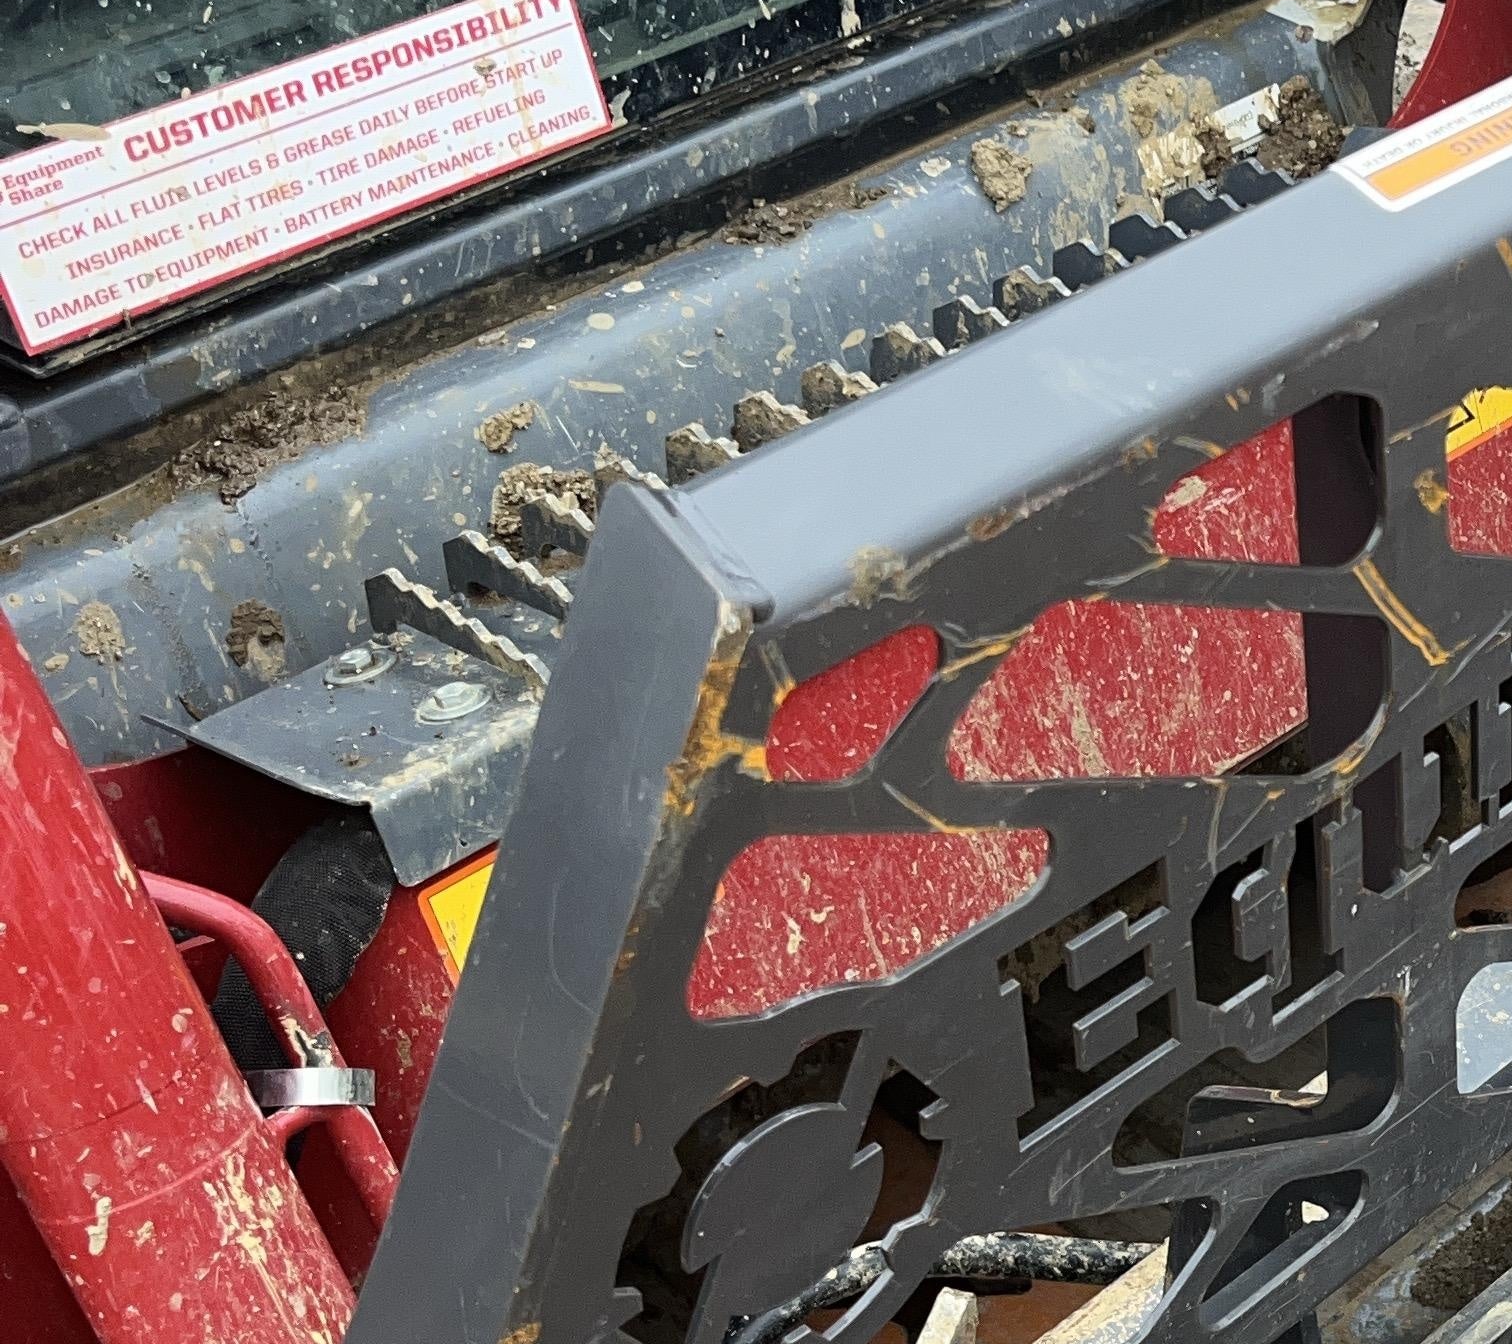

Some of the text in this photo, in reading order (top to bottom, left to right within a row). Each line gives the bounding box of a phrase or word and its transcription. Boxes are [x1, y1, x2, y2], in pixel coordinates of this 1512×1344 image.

[2, 146, 104, 189] Equipment
[18, 222, 88, 259] CHECK
[93, 209, 128, 234] ALL
[195, 159, 263, 196] LEVELS
[267, 152, 279, 169] &
[283, 123, 355, 164] GREASE
[358, 104, 412, 136] DAILY
[413, 79, 481, 116] BEFORE
[485, 58, 537, 88] START
[540, 48, 563, 70] UP
[65, 89, 547, 279] INSURANCE FLAT TIRES TIRE DAMAGE REFUELING
[123, 80, 308, 163] CUSTOMER
[9, 178, 64, 206] Share
[34, 104, 592, 329] DAMAGE TO EQUIPMENT BATTERY MAINTENANCE CLEANING
